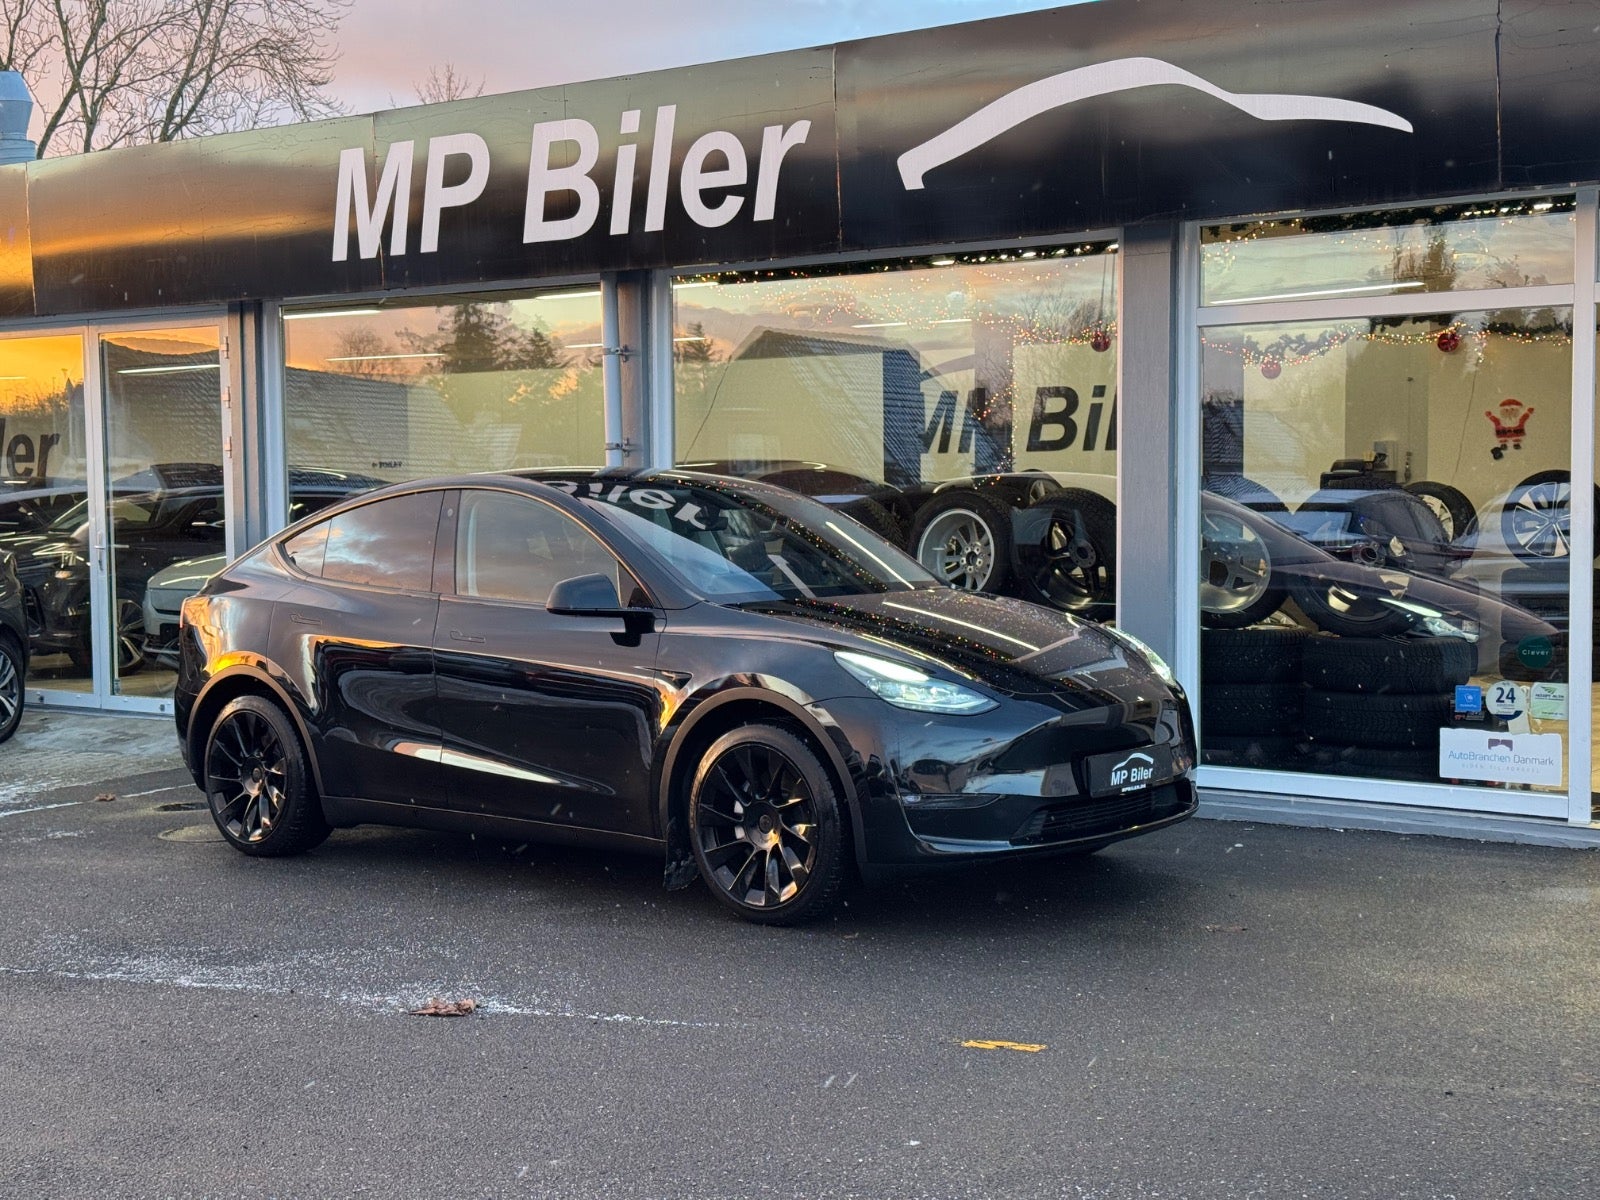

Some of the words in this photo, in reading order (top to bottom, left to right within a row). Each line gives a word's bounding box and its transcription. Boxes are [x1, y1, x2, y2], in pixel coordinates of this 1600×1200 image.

[332, 133, 491, 262] MP
[523, 104, 812, 244] Biler
[1495, 686, 1516, 704] 24
[1448, 750, 1511, 763] AutoBranchen
[1513, 754, 1554, 766] Danmark
[1111, 770, 1128, 786] MP
[1130, 767, 1153, 782] Biler
